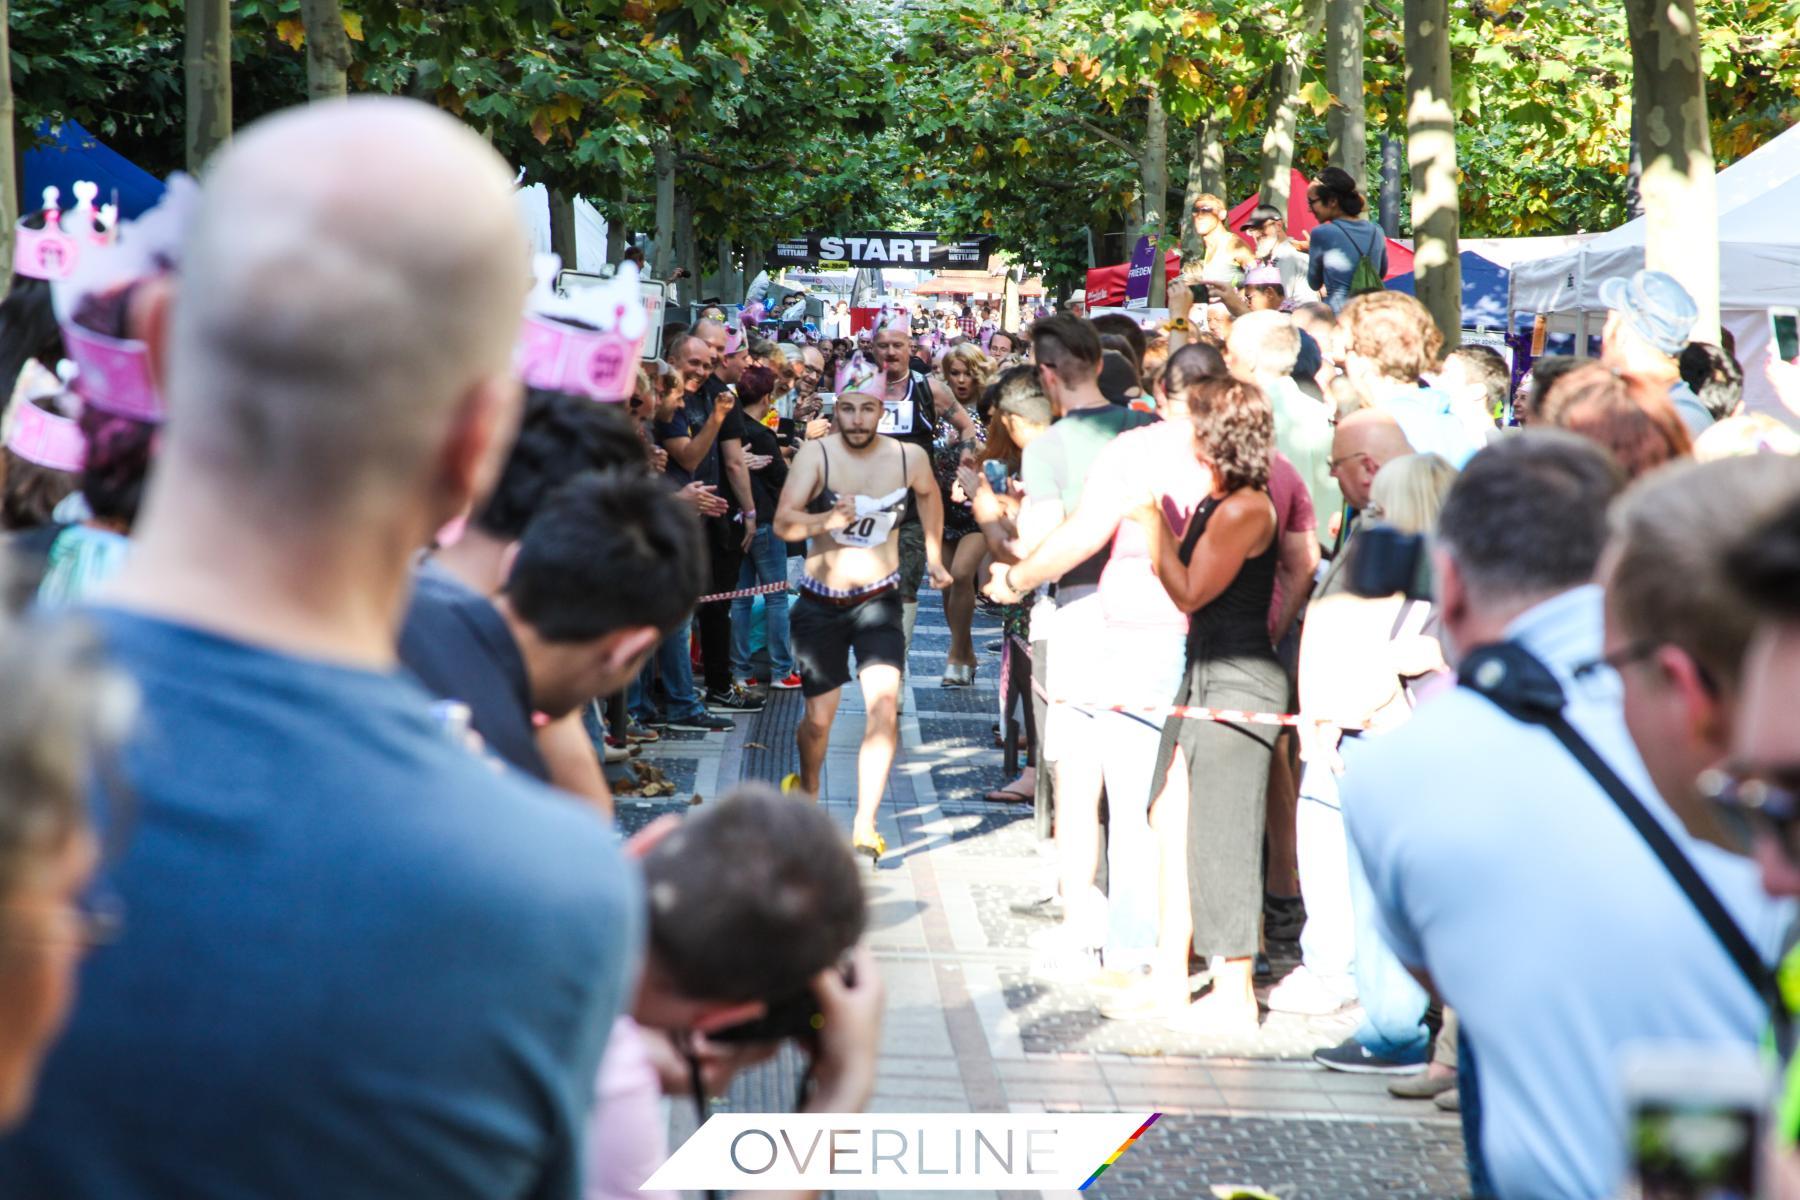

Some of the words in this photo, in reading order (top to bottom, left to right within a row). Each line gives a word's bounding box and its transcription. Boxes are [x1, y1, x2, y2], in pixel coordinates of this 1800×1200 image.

[777, 249, 808, 257] WETTLAUF
[819, 237, 937, 262] START
[1128, 265, 1152, 278] FRIEDEN
[880, 407, 899, 426] 21
[842, 516, 876, 538] 20
